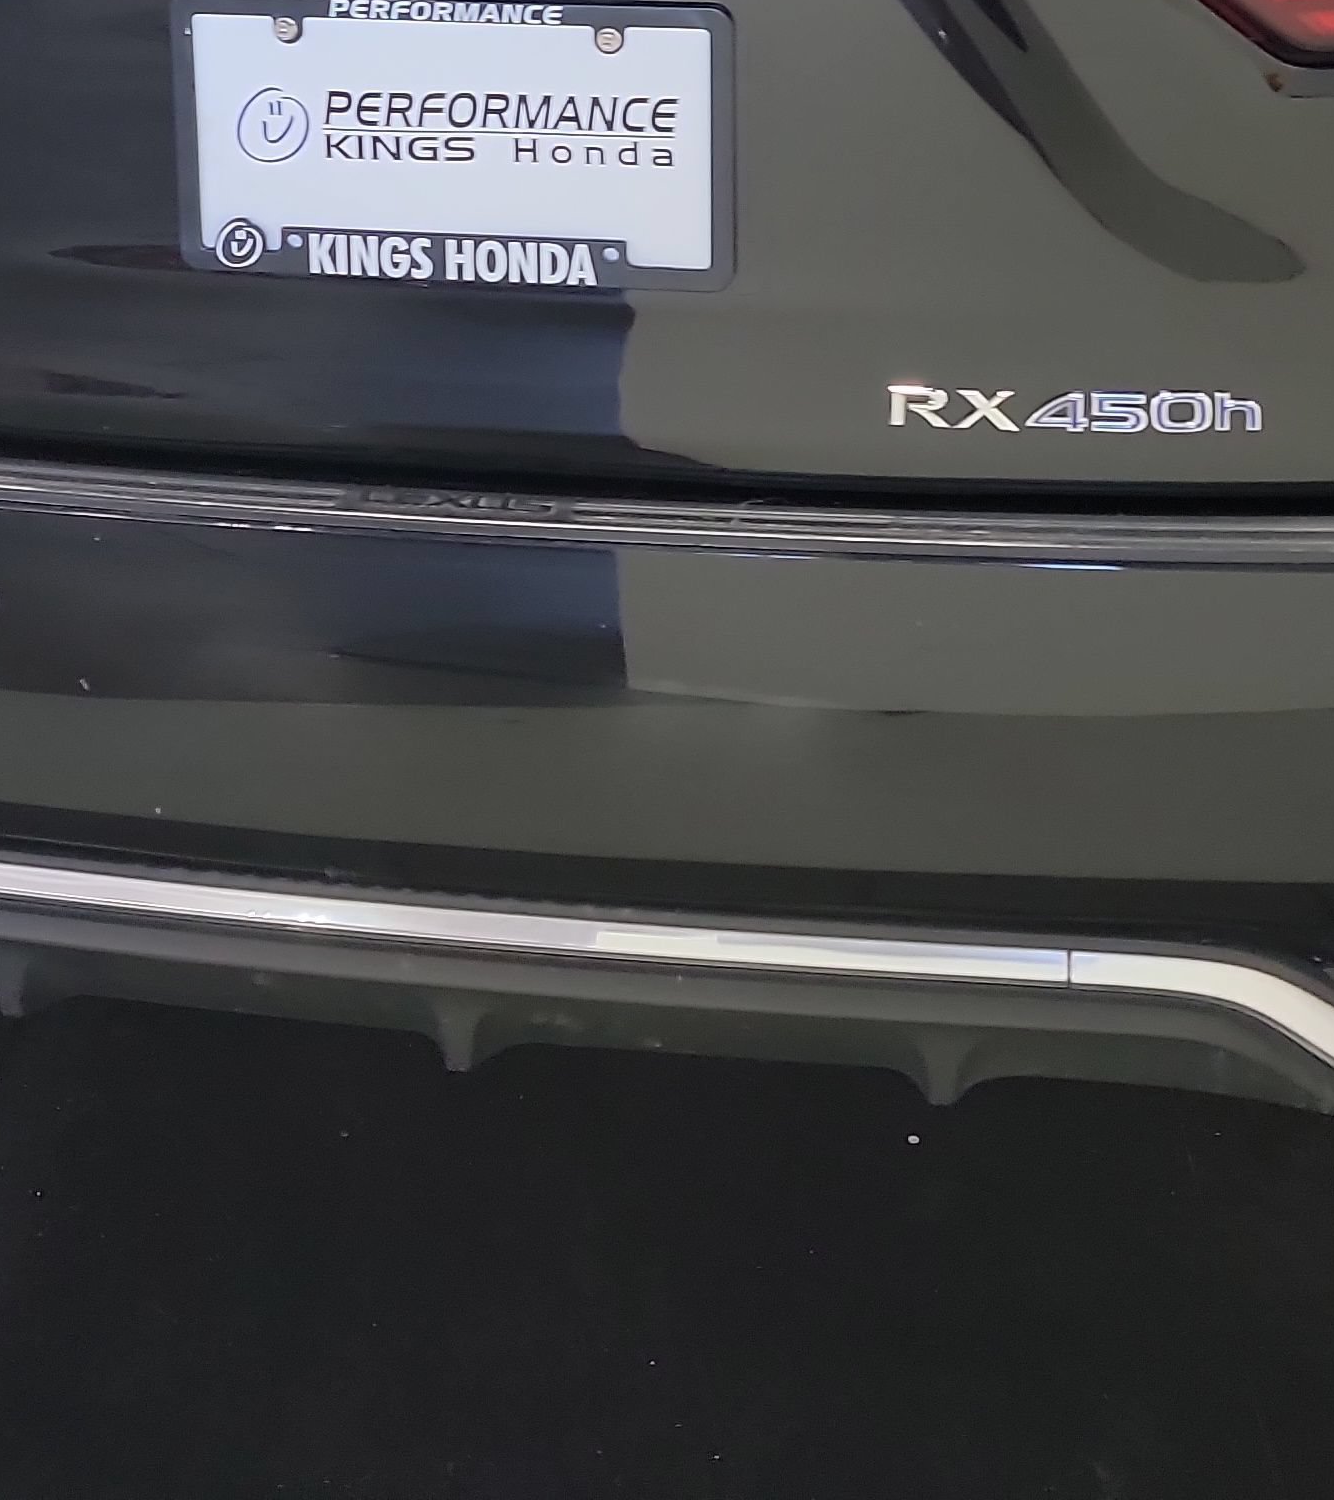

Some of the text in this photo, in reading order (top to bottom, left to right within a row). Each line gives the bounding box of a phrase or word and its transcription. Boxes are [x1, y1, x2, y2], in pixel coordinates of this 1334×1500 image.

[323, 90, 679, 133] PERFORMANCE
[324, 134, 676, 168] KINGS Honda
[308, 233, 598, 286] KINGS HONDA
